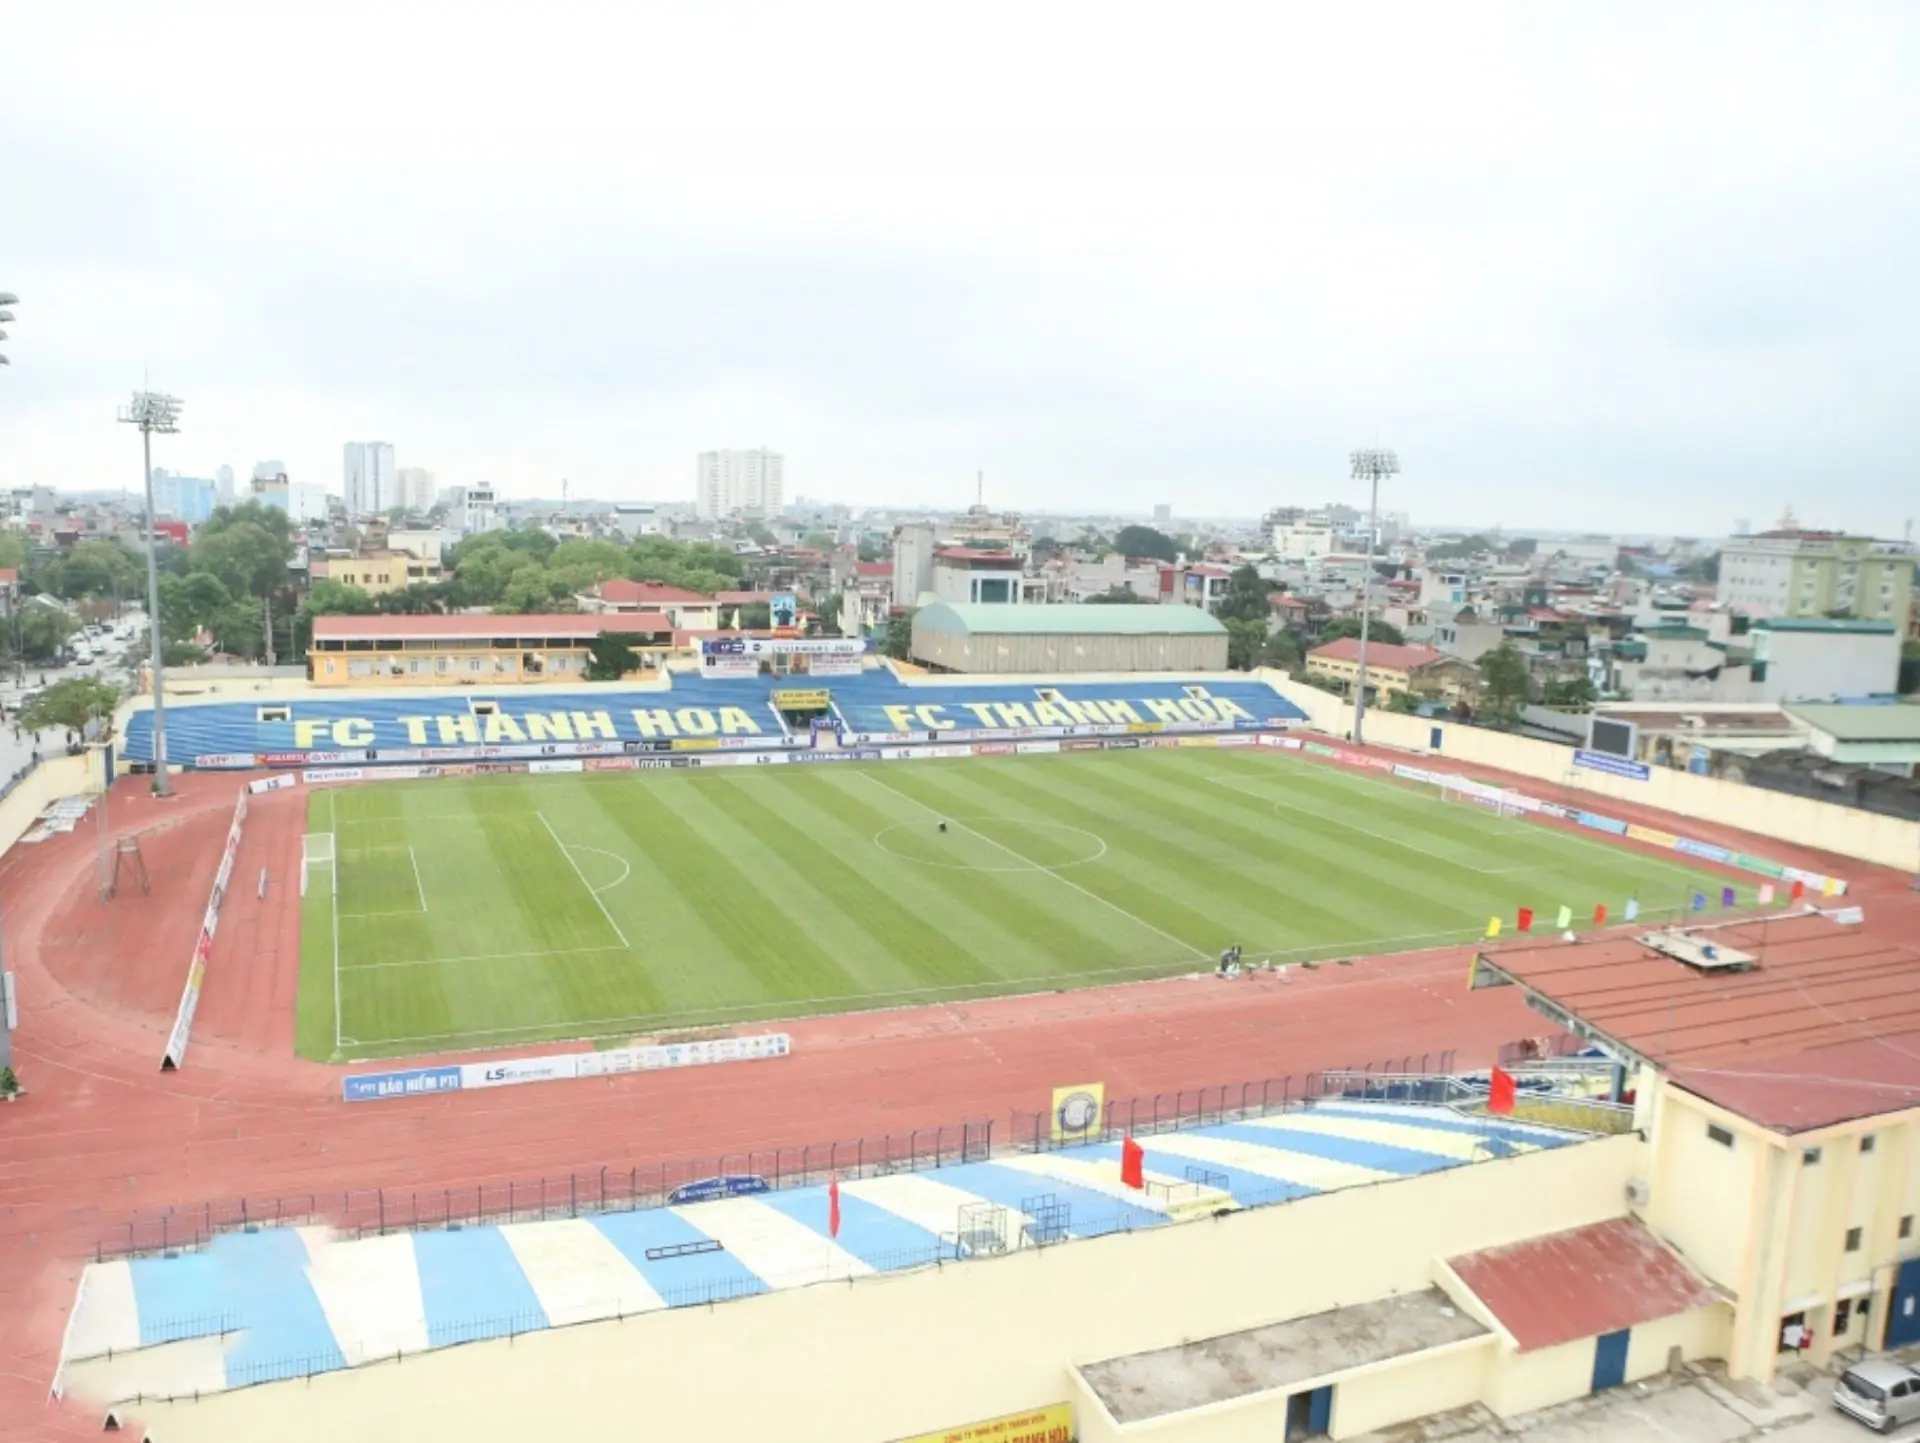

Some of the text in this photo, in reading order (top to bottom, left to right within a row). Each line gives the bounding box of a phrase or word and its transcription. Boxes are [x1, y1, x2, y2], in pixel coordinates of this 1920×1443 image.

[293, 717, 376, 749] FC
[631, 706, 762, 737] HOA
[883, 704, 955, 731] FC
[485, 1068, 505, 1081] LS
